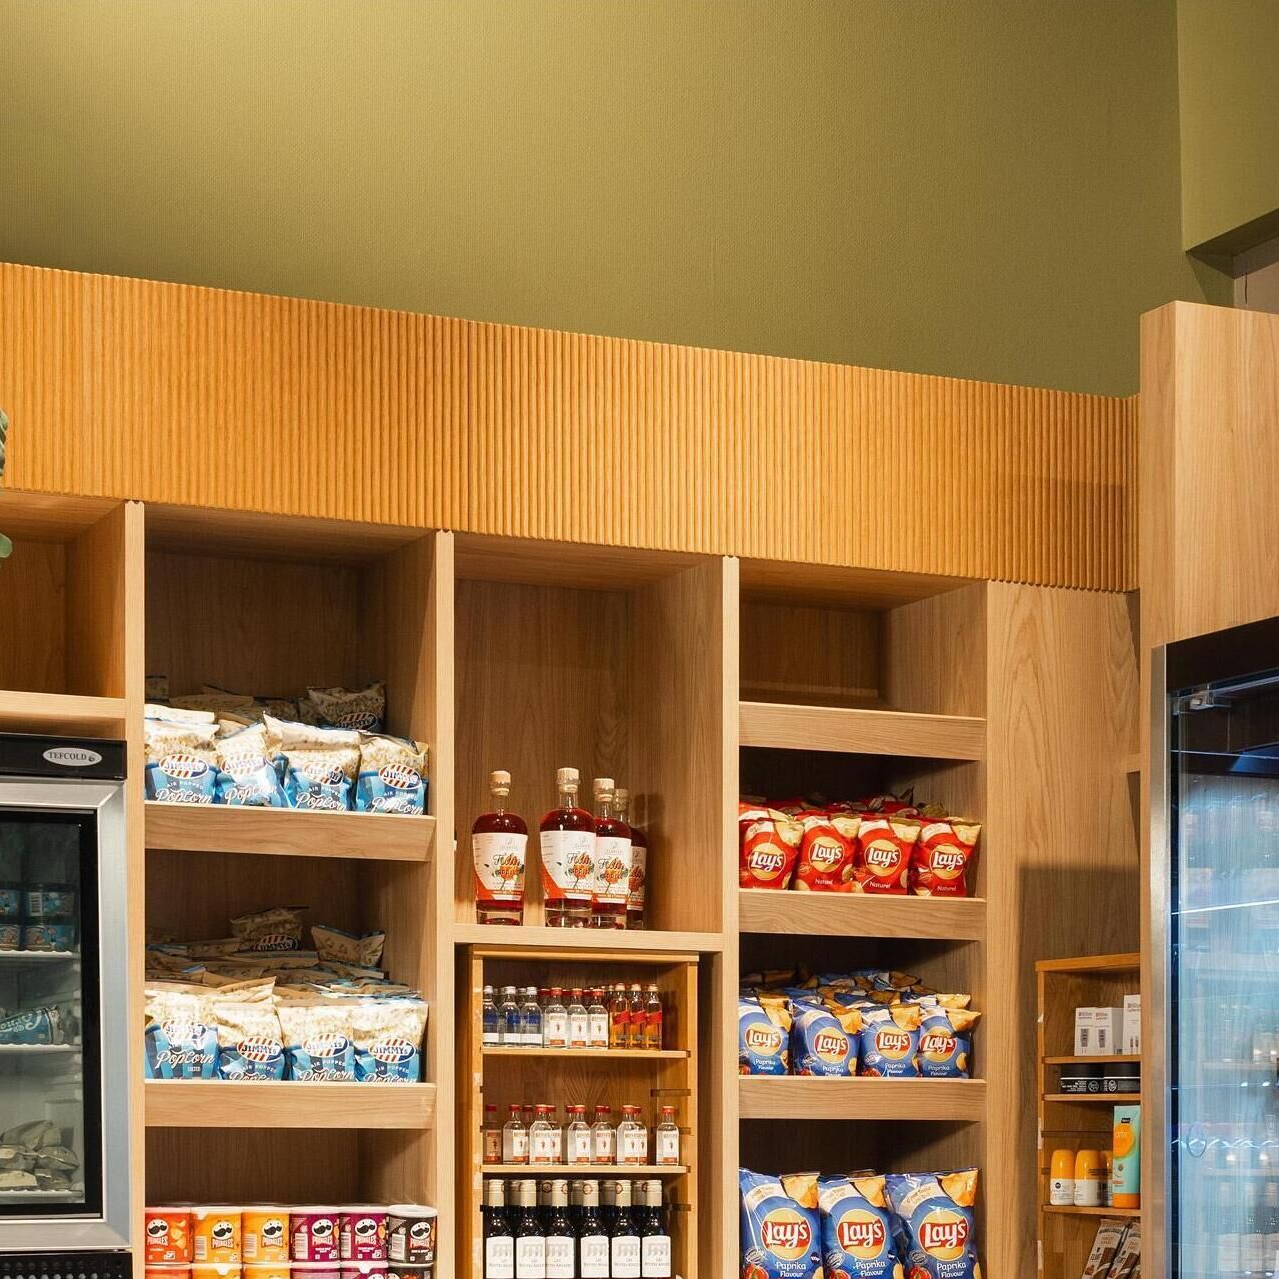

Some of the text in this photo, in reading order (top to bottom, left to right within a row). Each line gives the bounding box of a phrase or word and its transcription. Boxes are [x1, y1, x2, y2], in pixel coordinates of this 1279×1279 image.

[48, 751, 88, 761] TEFCOLD
[750, 851, 782, 871] Lay's
[811, 842, 842, 865] Lay's
[867, 846, 899, 868] Lay's
[932, 850, 964, 871] Lay's
[748, 1030, 782, 1049] Lay's
[816, 1035, 847, 1055] Lay's
[878, 1031, 909, 1052] Lay's
[922, 1035, 954, 1054] Lay's
[764, 1219, 808, 1250] Lay's
[842, 1219, 883, 1249] Lay's
[924, 1222, 967, 1250] Lay's
[776, 1263, 806, 1272] Paprika
[855, 1260, 885, 1271] Paprika
[860, 1269, 884, 1277] Flavour
[936, 1263, 967, 1272] Paprika
[941, 1270, 964, 1278] Flavour
